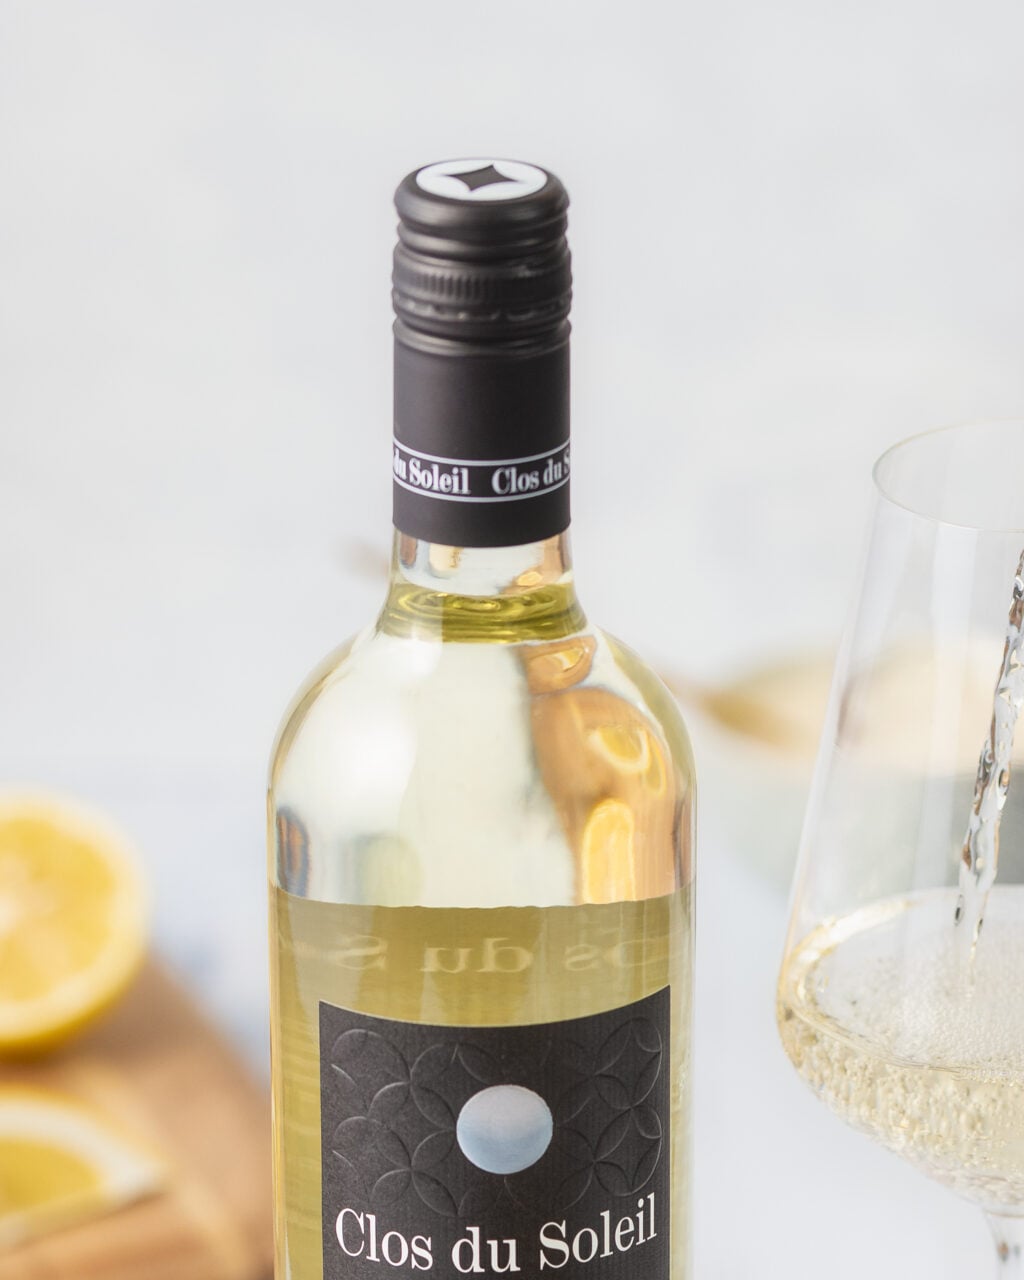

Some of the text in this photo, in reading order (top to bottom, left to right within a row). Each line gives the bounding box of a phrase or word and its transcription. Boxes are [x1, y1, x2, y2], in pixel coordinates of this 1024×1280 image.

[409, 457, 471, 495] Soleil
[491, 466, 540, 495] Clos
[543, 458, 562, 486] du
[335, 1191, 658, 1274] Clos du Soleil
